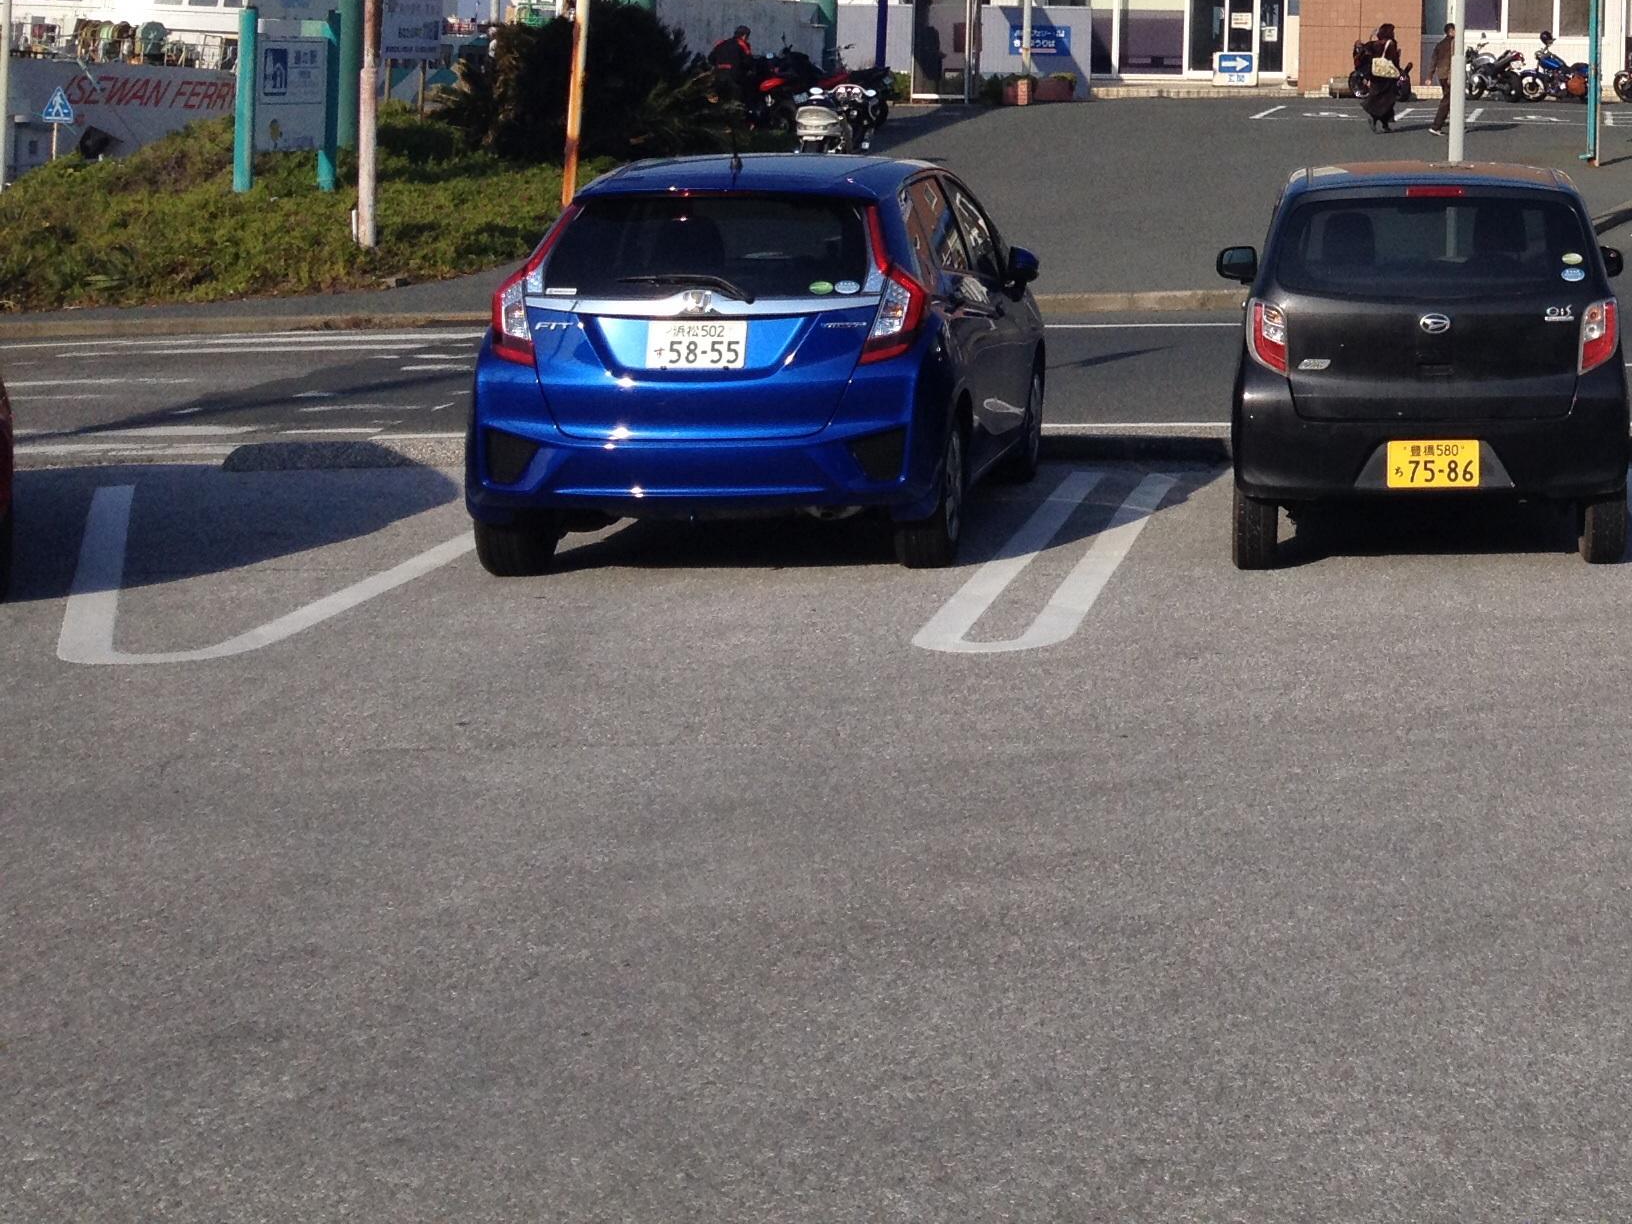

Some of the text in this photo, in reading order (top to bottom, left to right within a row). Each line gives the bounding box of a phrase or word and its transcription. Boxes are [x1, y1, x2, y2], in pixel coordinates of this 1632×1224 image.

[66, 74, 173, 108] ISEWAN
[535, 321, 574, 330] FIT
[668, 340, 740, 364] 58-55
[1408, 459, 1474, 483] 75-86
